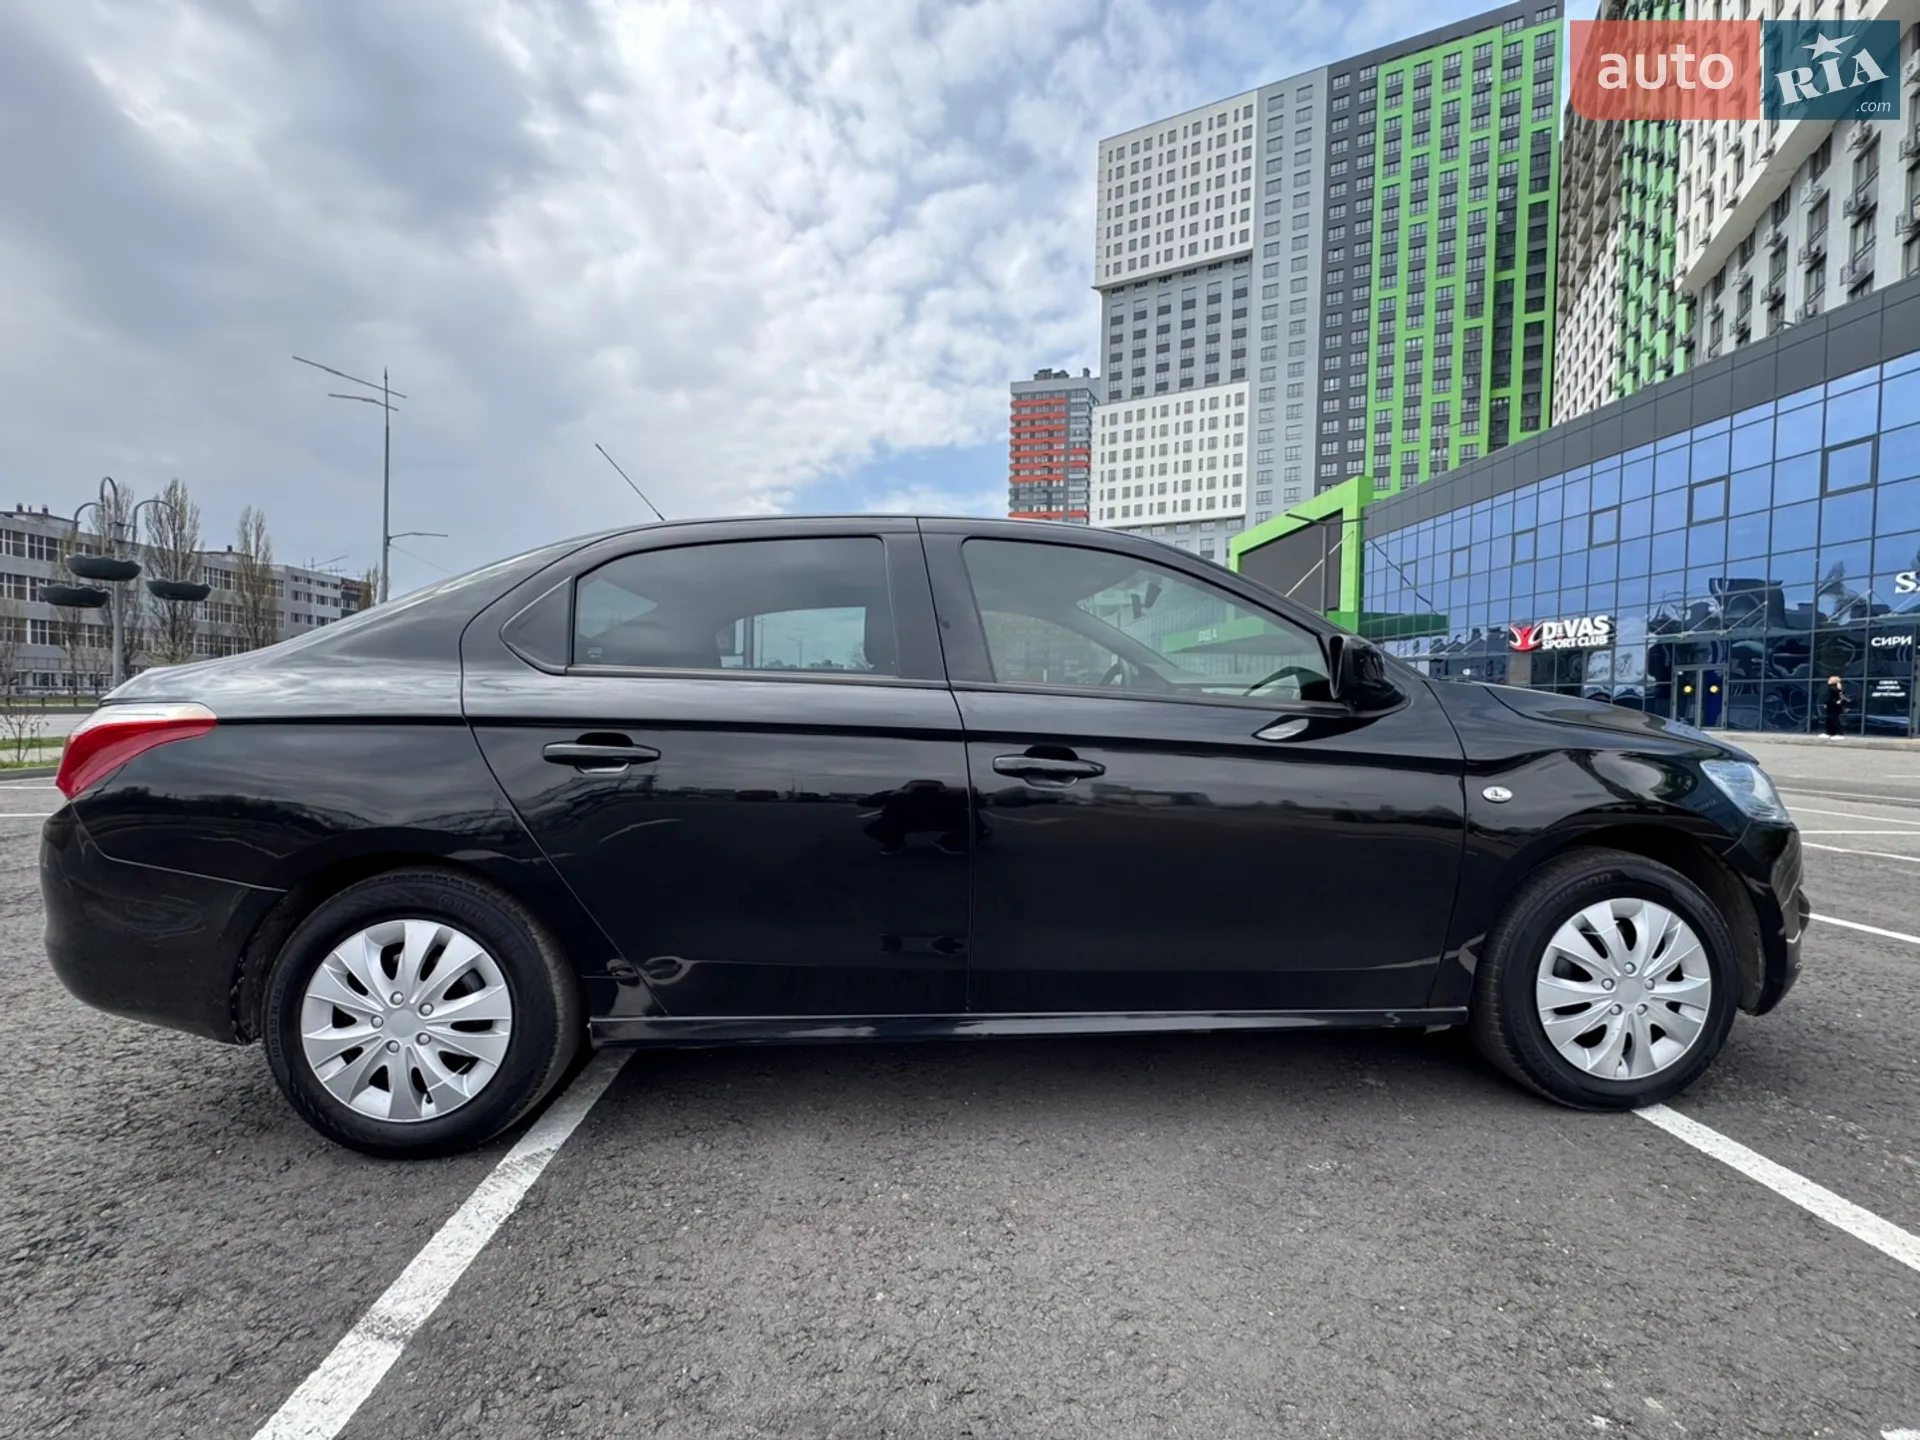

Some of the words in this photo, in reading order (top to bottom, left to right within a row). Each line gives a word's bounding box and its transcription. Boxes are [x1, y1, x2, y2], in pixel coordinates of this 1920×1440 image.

[1542, 638, 1576, 650] SPORT
[1578, 635, 1608, 647] CLUB
[1871, 635, 1912, 647] СИРИ
